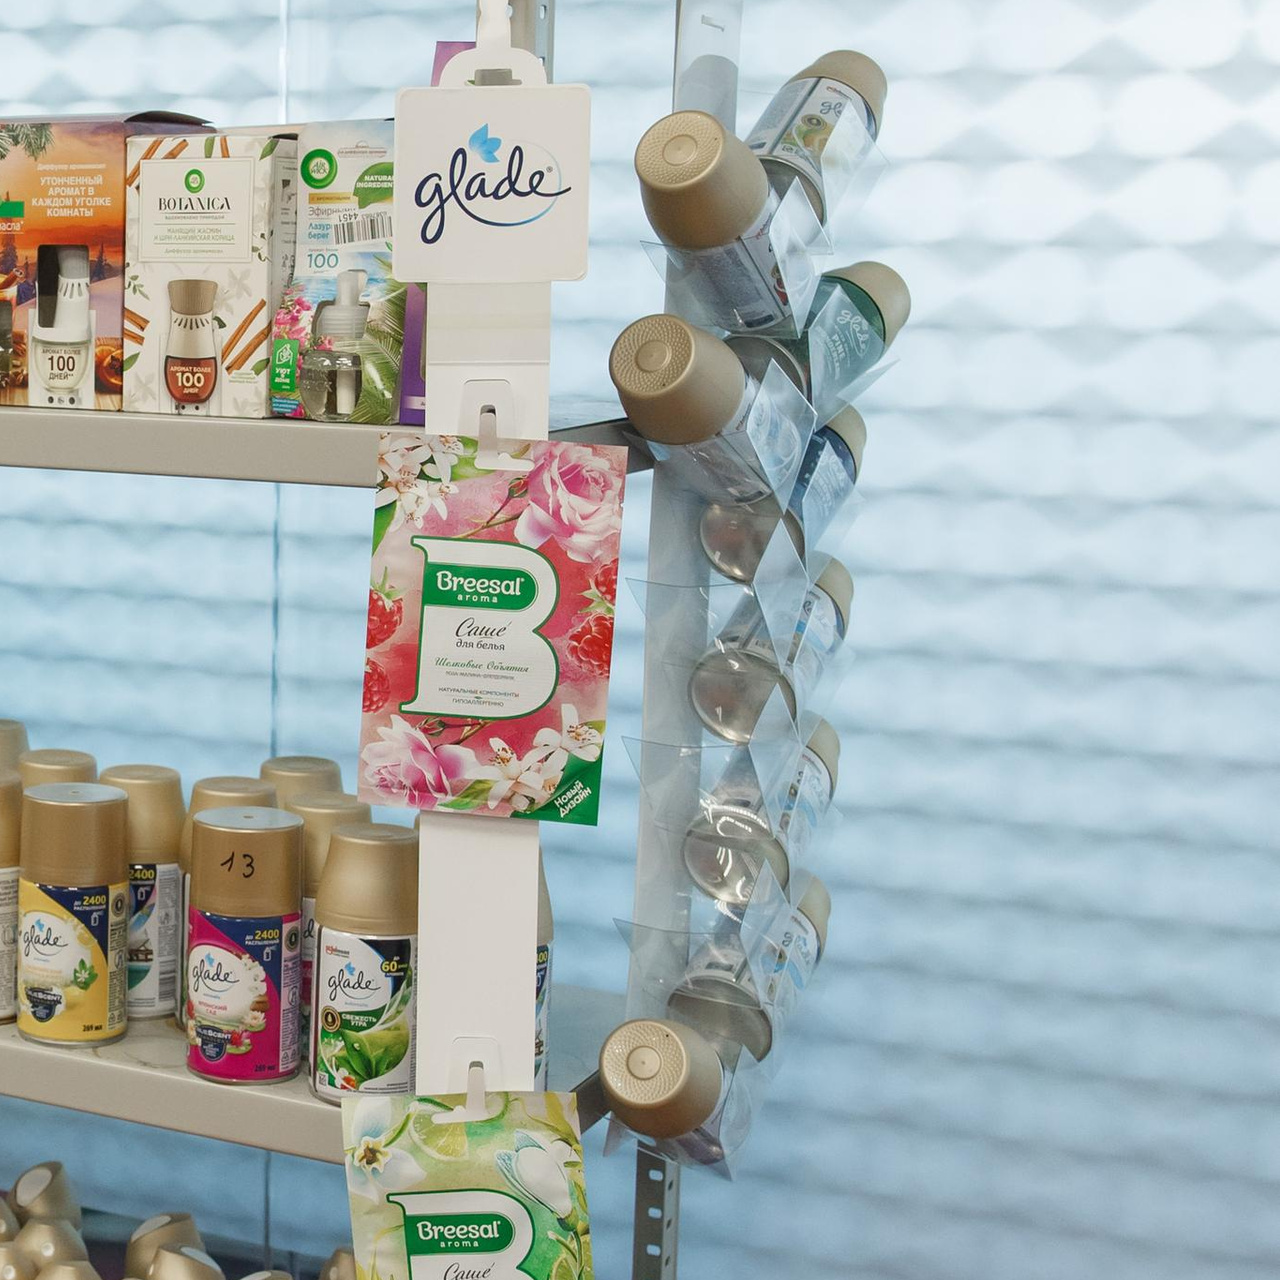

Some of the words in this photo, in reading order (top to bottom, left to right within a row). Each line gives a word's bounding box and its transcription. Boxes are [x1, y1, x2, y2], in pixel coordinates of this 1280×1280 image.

[40, 174, 103, 187] УТОНЧЕННЫЙ
[48, 187, 86, 196] АРОМАТ
[88, 187, 95, 196] В
[414, 145, 572, 245] glade
[32, 197, 73, 208] КАЖДОМ
[75, 197, 111, 207] УГОЛКЕ
[158, 197, 231, 211] BOTANICA
[47, 207, 94, 217] КОМНАТЫ
[338, 213, 359, 223] 4451
[308, 222, 331, 231] Лазур
[308, 230, 330, 240] берег
[307, 253, 339, 269] 100
[48, 355, 76, 372] 100
[176, 373, 205, 387] 100
[436, 570, 522, 596] Breesal
[457, 594, 498, 603] aroma
[456, 639, 474, 648] для
[476, 640, 505, 651] белья
[435, 656, 483, 670] Шелковые
[486, 661, 530, 673] Объятия
[439, 687, 478, 695] НАТУРАЛЬНЫЕ
[479, 690, 520, 698] КОМПОНЕНТЫ
[220, 851, 255, 878] 13
[129, 870, 155, 880] 2400
[83, 895, 107, 905] 2400
[254, 929, 280, 940] 2400
[23, 924, 69, 957] glade
[381, 961, 398, 972] 60
[192, 960, 240, 993] glade
[327, 968, 382, 1002] glade
[205, 1008, 217, 1017] САД
[342, 1013, 377, 1023] СВЕЖЕСТЬ
[417, 1221, 500, 1241] Breesal
[440, 1240, 479, 1248] aroma
